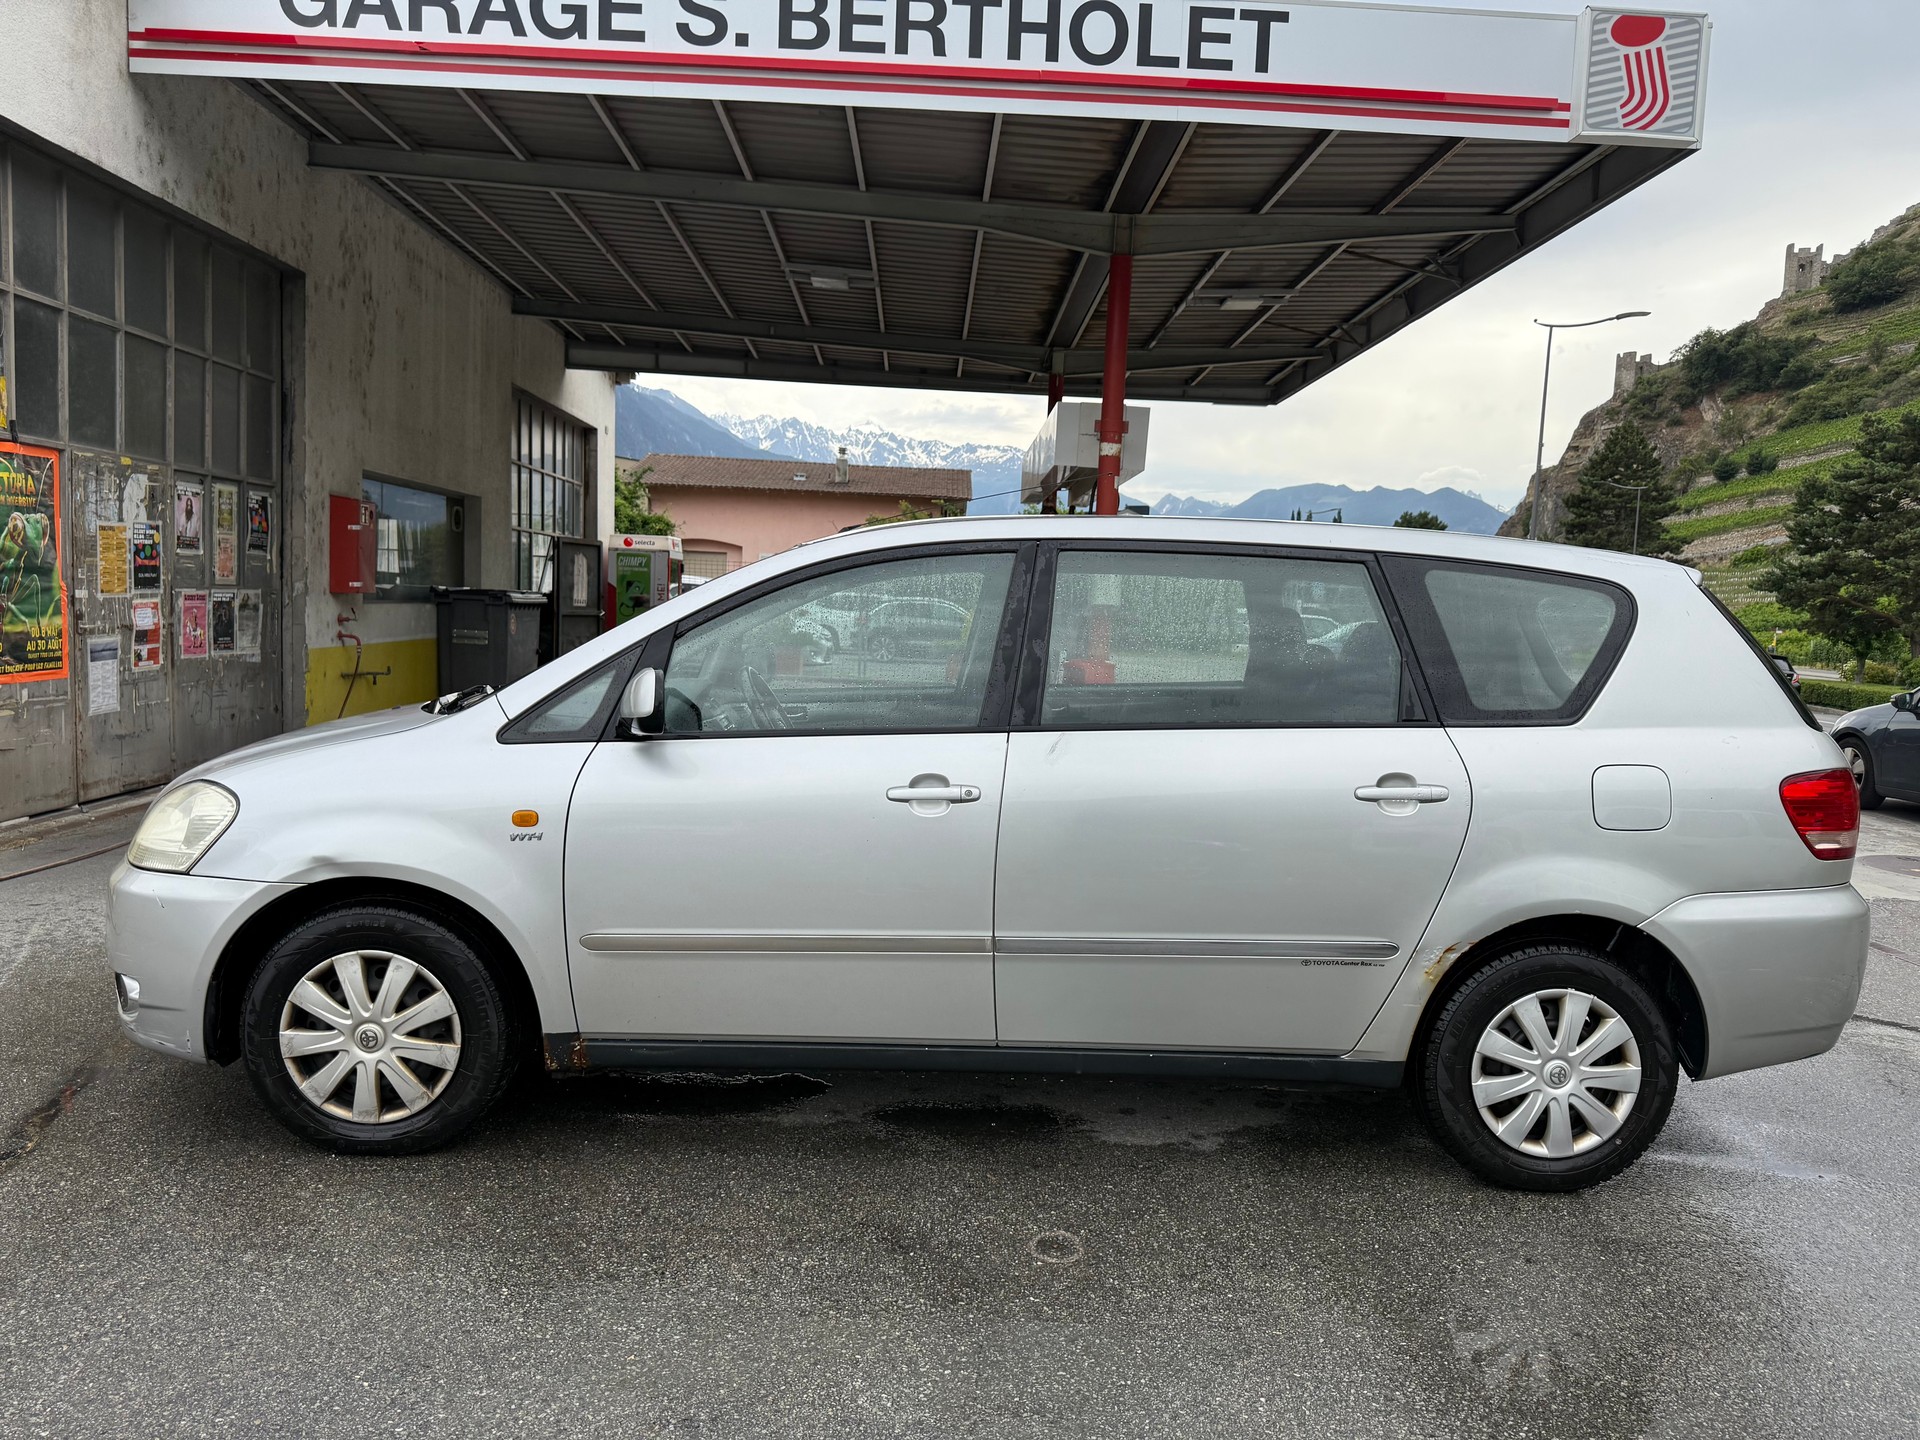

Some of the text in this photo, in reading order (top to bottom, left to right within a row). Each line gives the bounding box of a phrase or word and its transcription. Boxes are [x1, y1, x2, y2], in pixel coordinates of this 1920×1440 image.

[676, 0, 749, 47] S.
[777, 0, 1290, 73] BERTHOLET
[618, 555, 647, 567] CHIMPY
[31, 627, 40, 638] DU
[41, 626, 46, 637] 8
[26, 640, 36, 652] AU
[37, 640, 46, 651] 30
